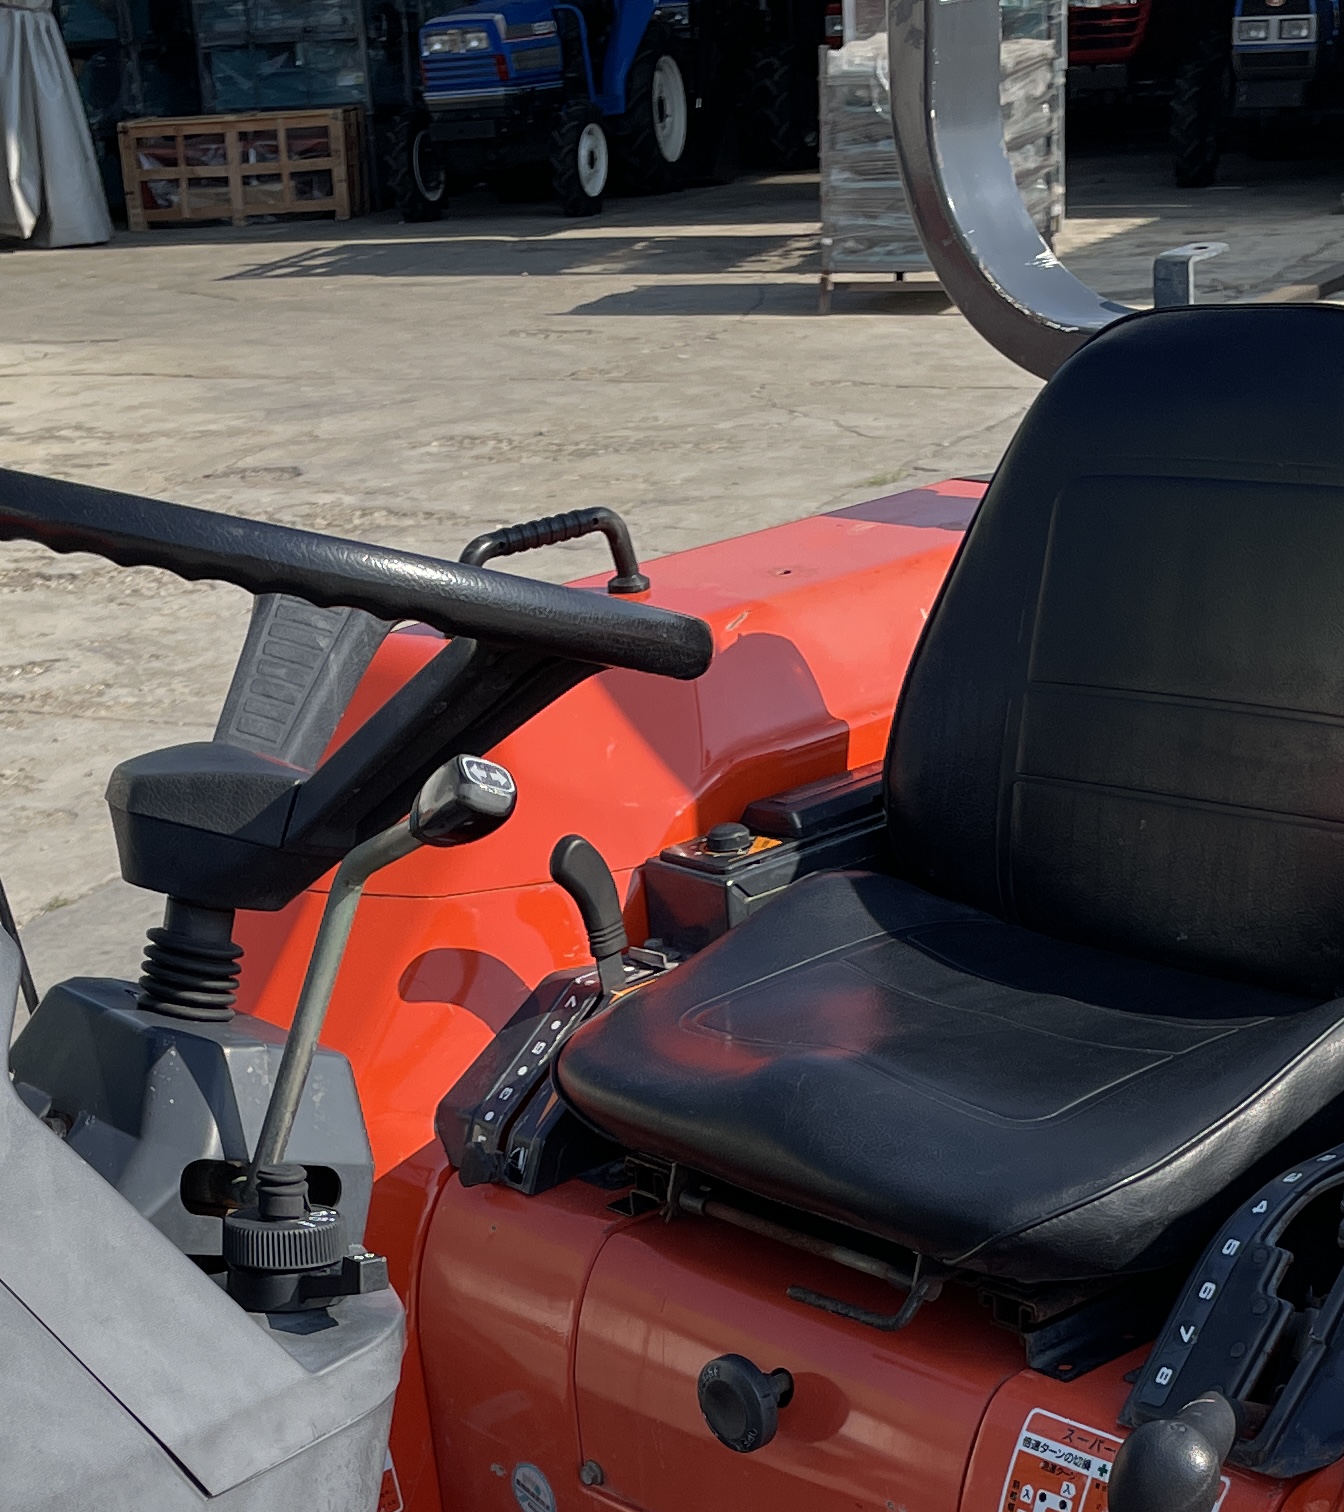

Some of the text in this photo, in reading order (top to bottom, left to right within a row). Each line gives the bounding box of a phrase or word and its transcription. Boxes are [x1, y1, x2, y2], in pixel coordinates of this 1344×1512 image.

[1252, 1200, 1268, 1214] 4
[1221, 1238, 1241, 1256] 5
[1198, 1281, 1216, 1300] 6
[1179, 1325, 1195, 1343] 7
[1155, 1366, 1173, 1385] 8
